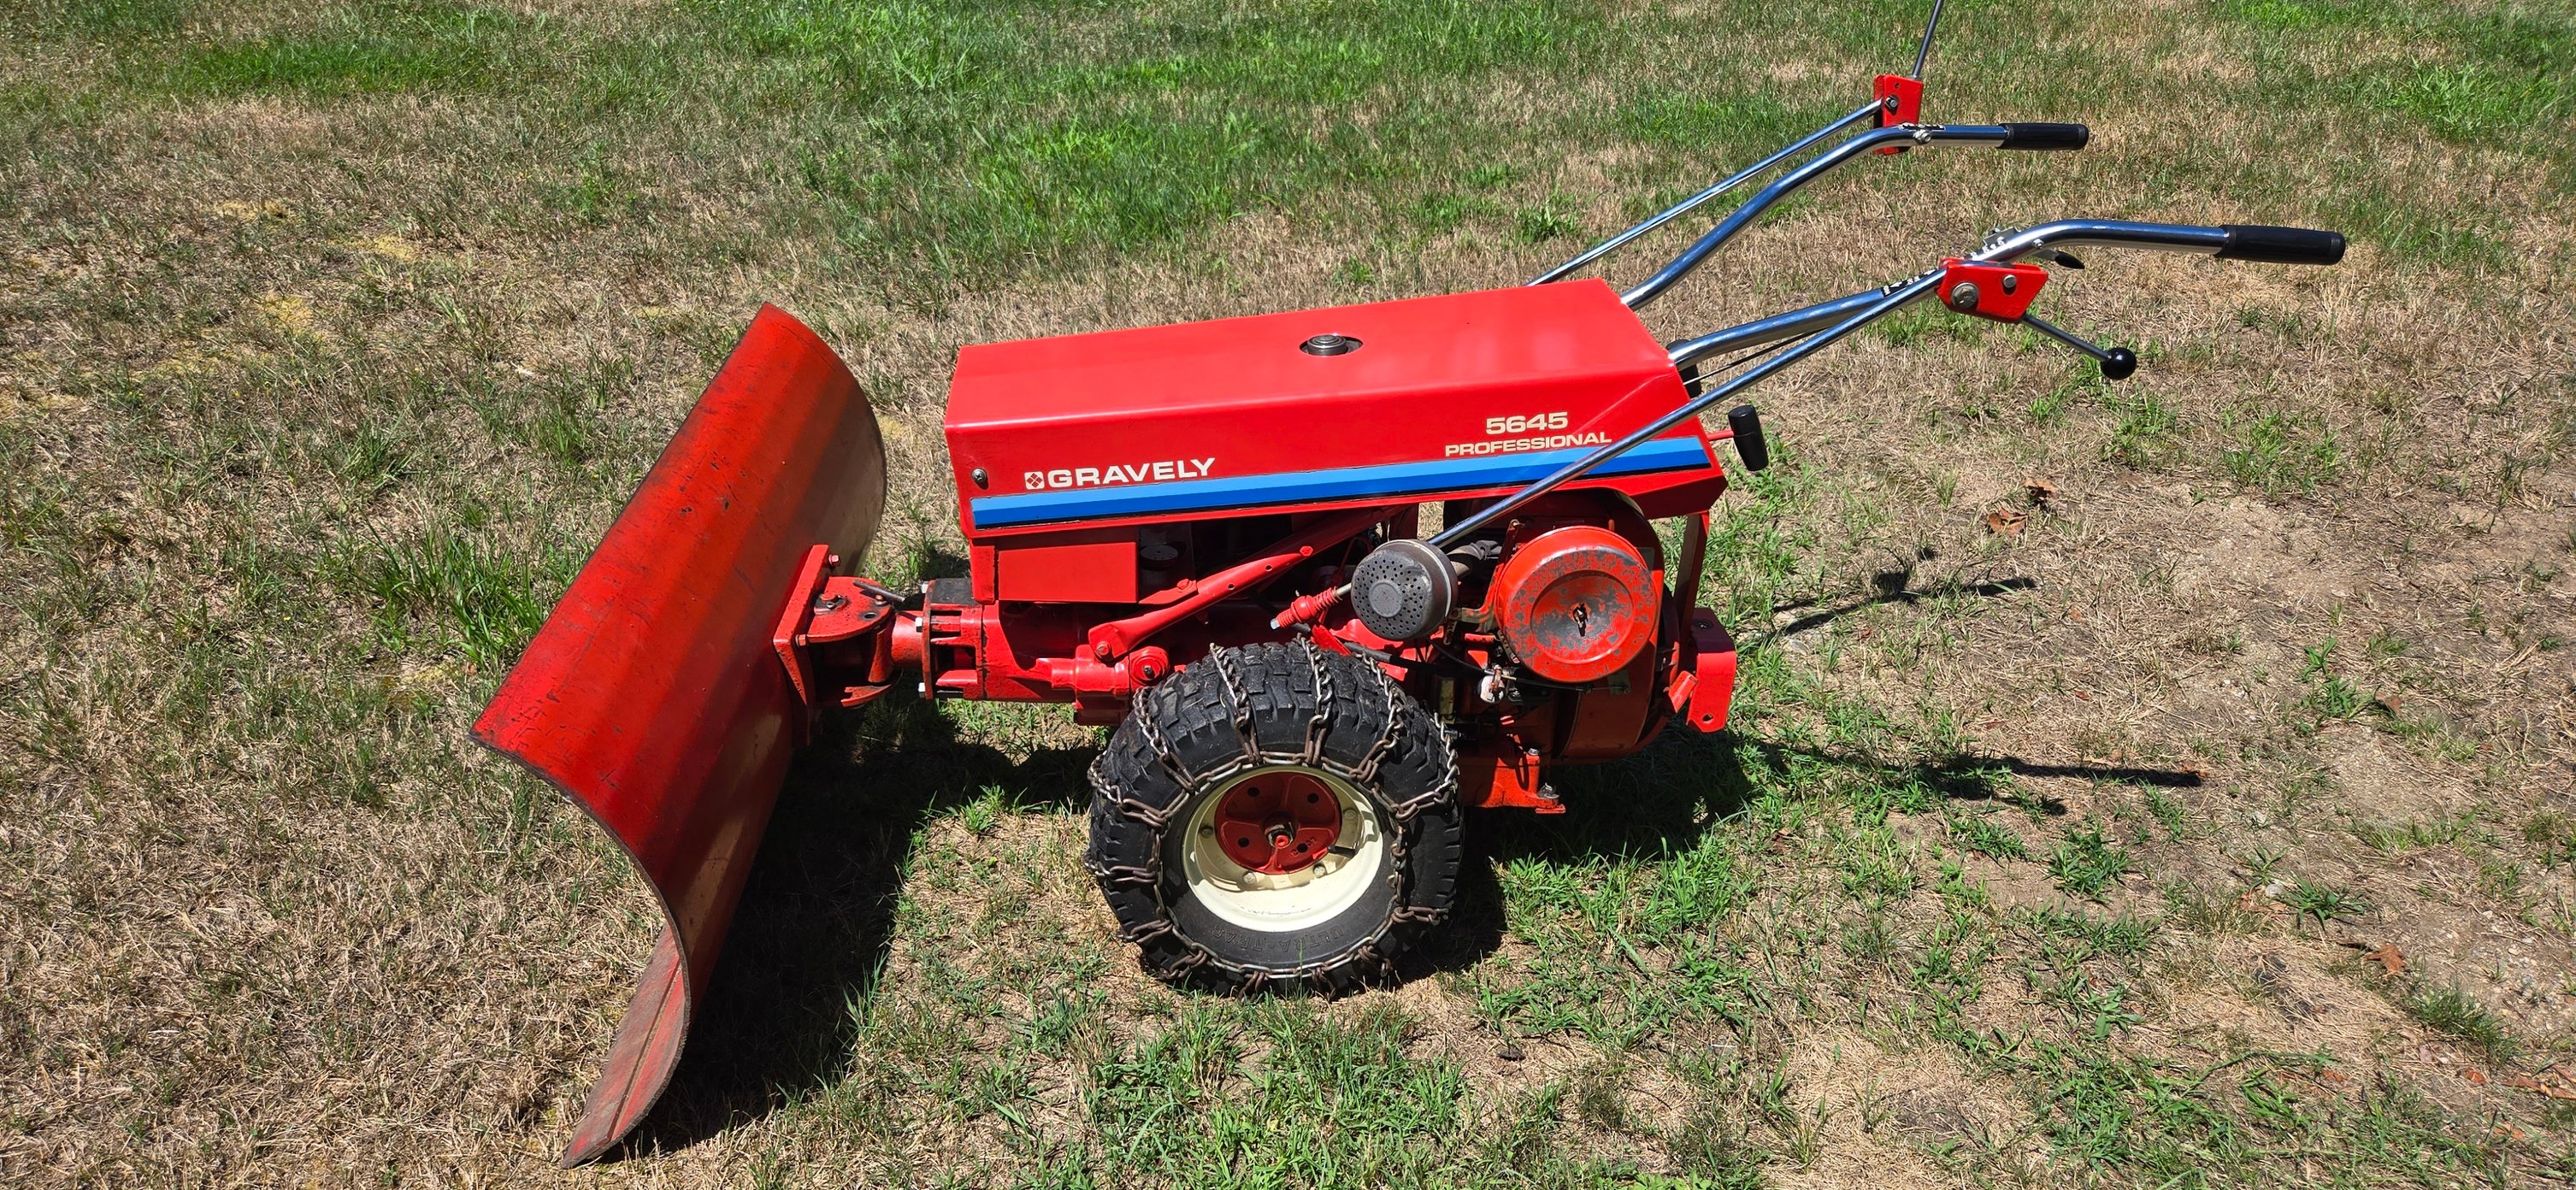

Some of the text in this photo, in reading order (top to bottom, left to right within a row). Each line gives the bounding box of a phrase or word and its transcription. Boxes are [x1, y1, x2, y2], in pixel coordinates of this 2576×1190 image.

[1486, 412, 1568, 434] 5645
[1446, 432, 1612, 457] PROFESSIONAL
[1048, 458, 1215, 486] GRAVELY
